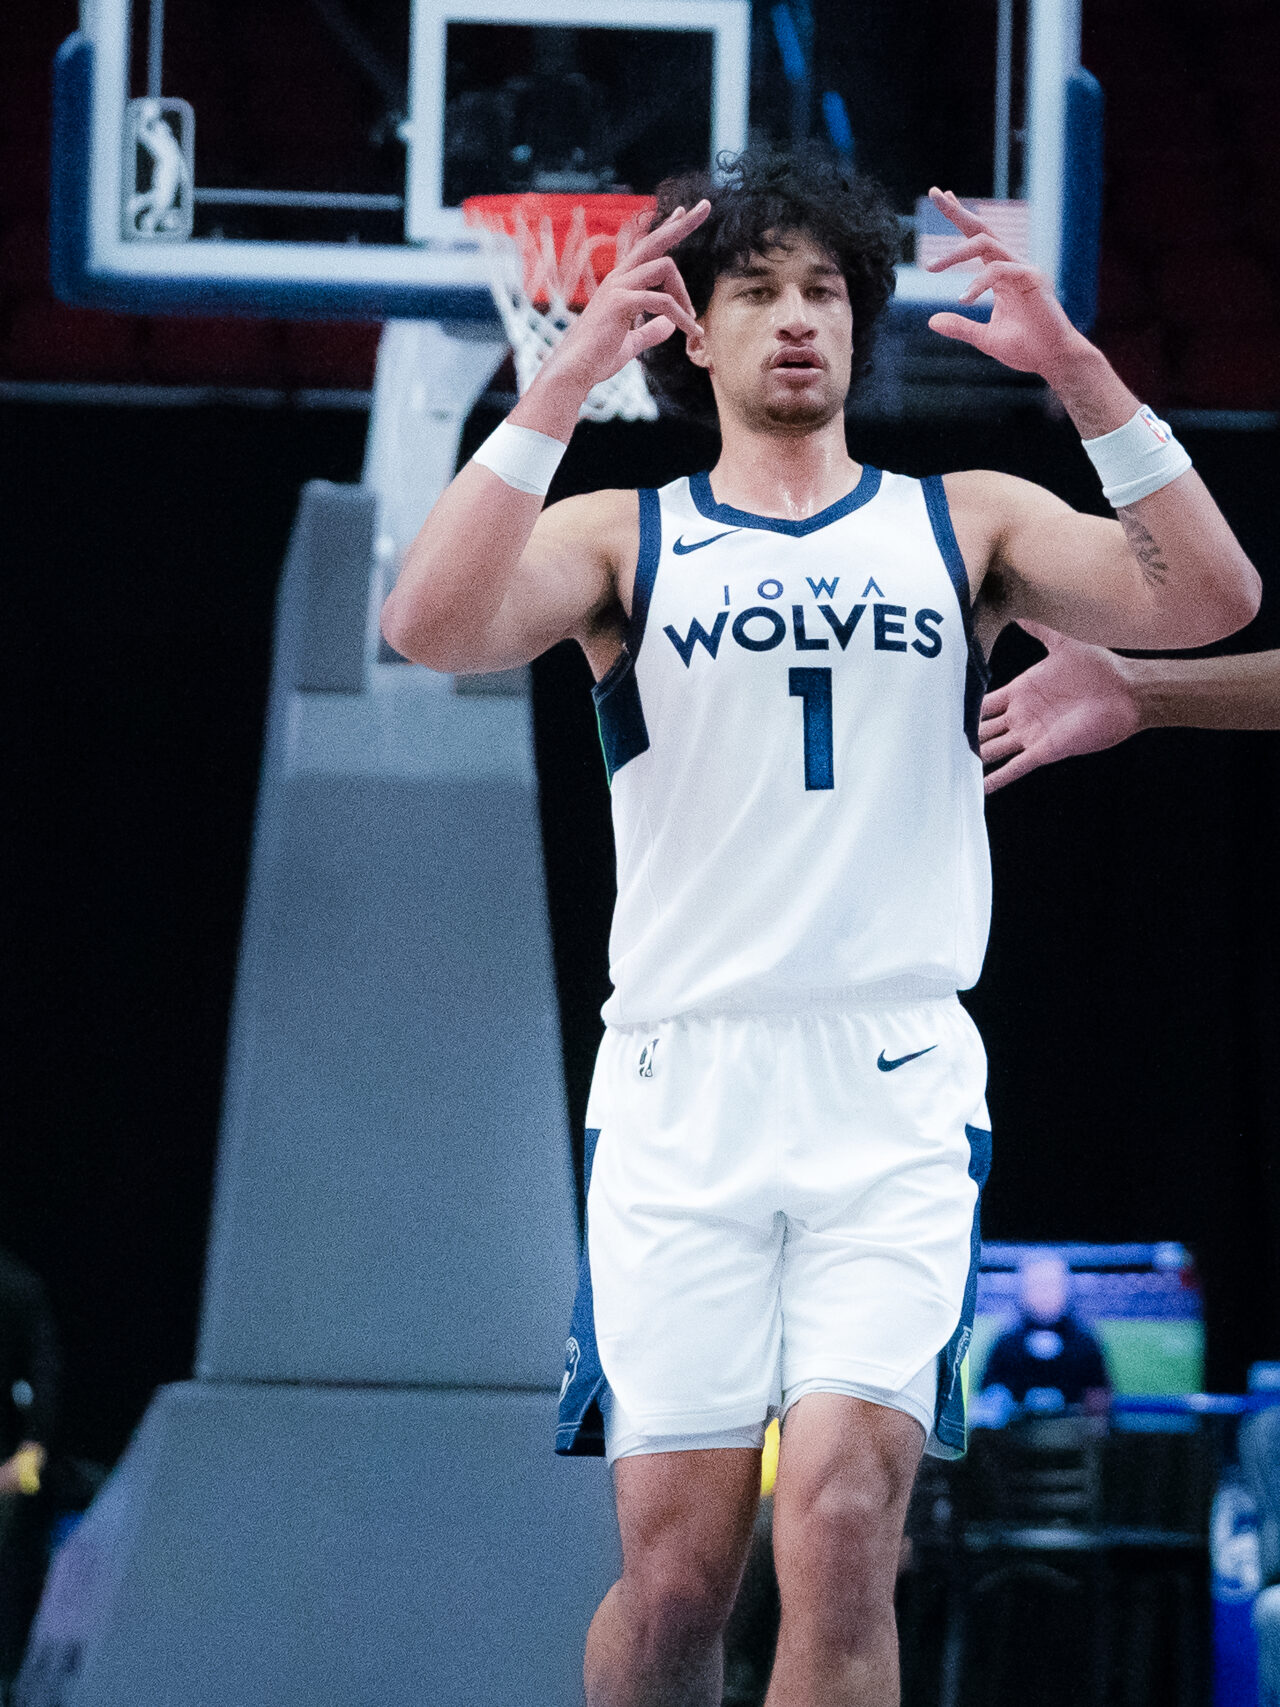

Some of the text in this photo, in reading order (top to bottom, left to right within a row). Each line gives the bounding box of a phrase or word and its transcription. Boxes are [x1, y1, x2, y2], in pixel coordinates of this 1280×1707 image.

[723, 576, 885, 606] IOWA
[662, 602, 945, 669] WOLVES
[788, 666, 835, 792] 1
